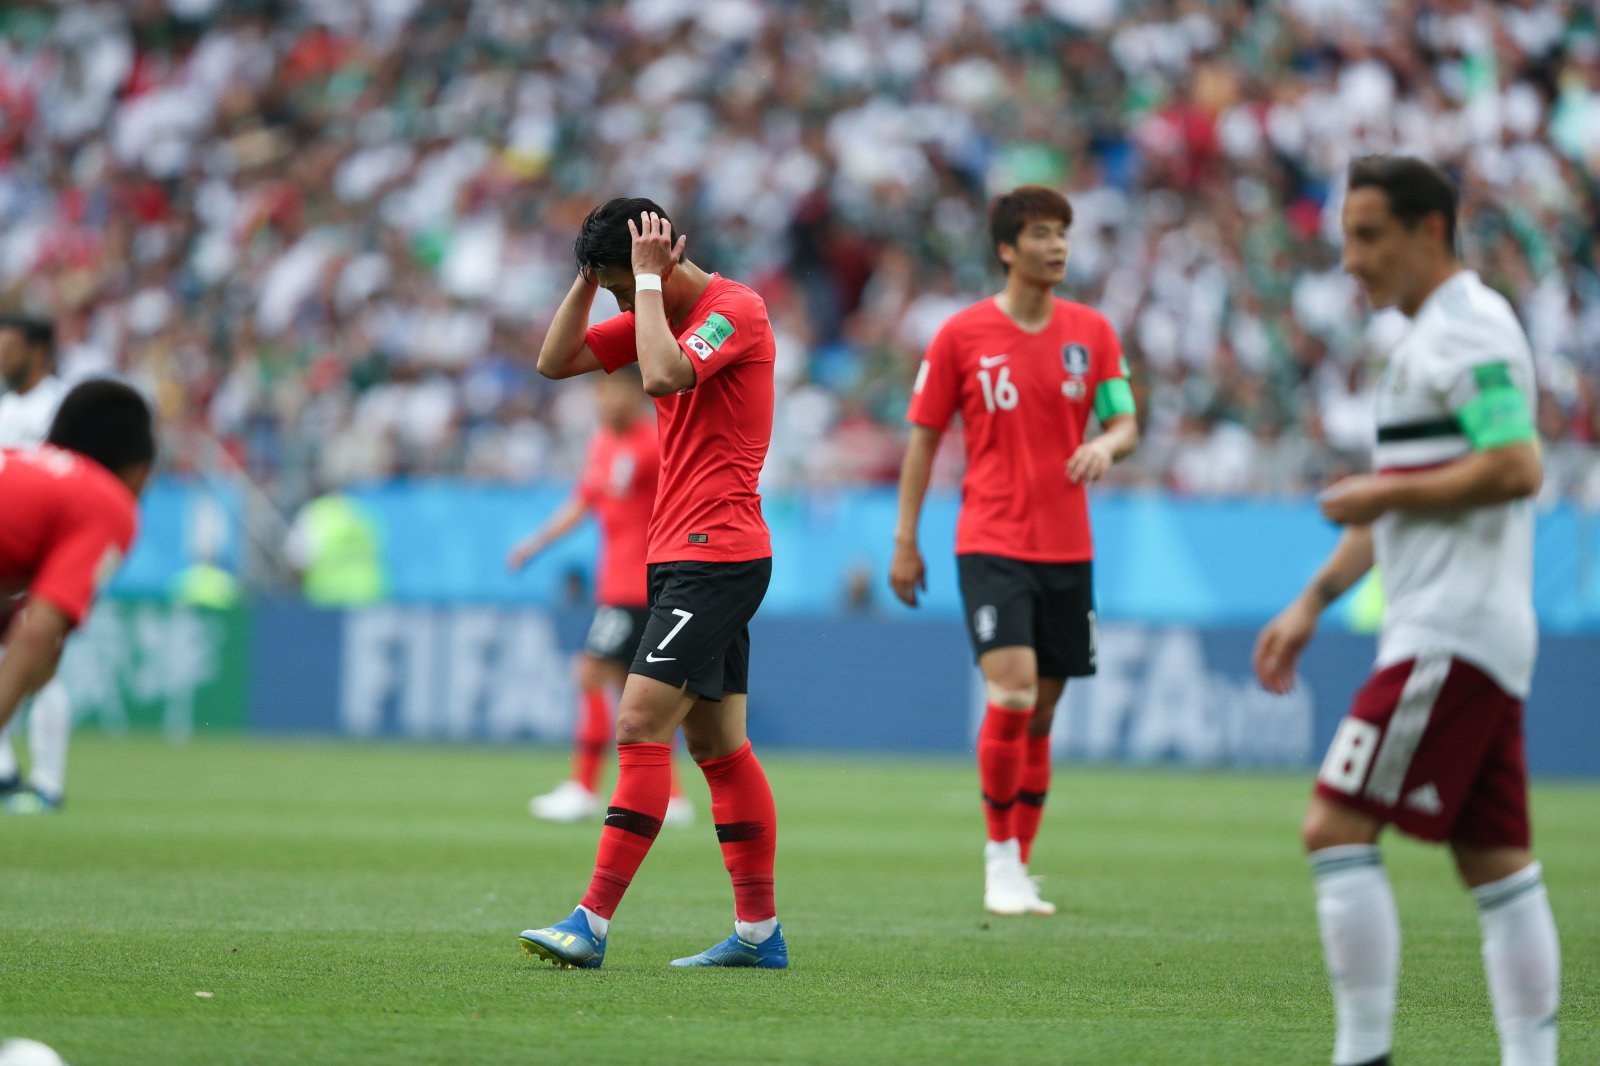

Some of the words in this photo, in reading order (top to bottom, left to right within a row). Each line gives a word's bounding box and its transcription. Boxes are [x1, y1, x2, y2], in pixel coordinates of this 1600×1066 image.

[976, 366, 1019, 413] 16
[657, 608, 694, 651] 7
[340, 606, 573, 738] FIFA
